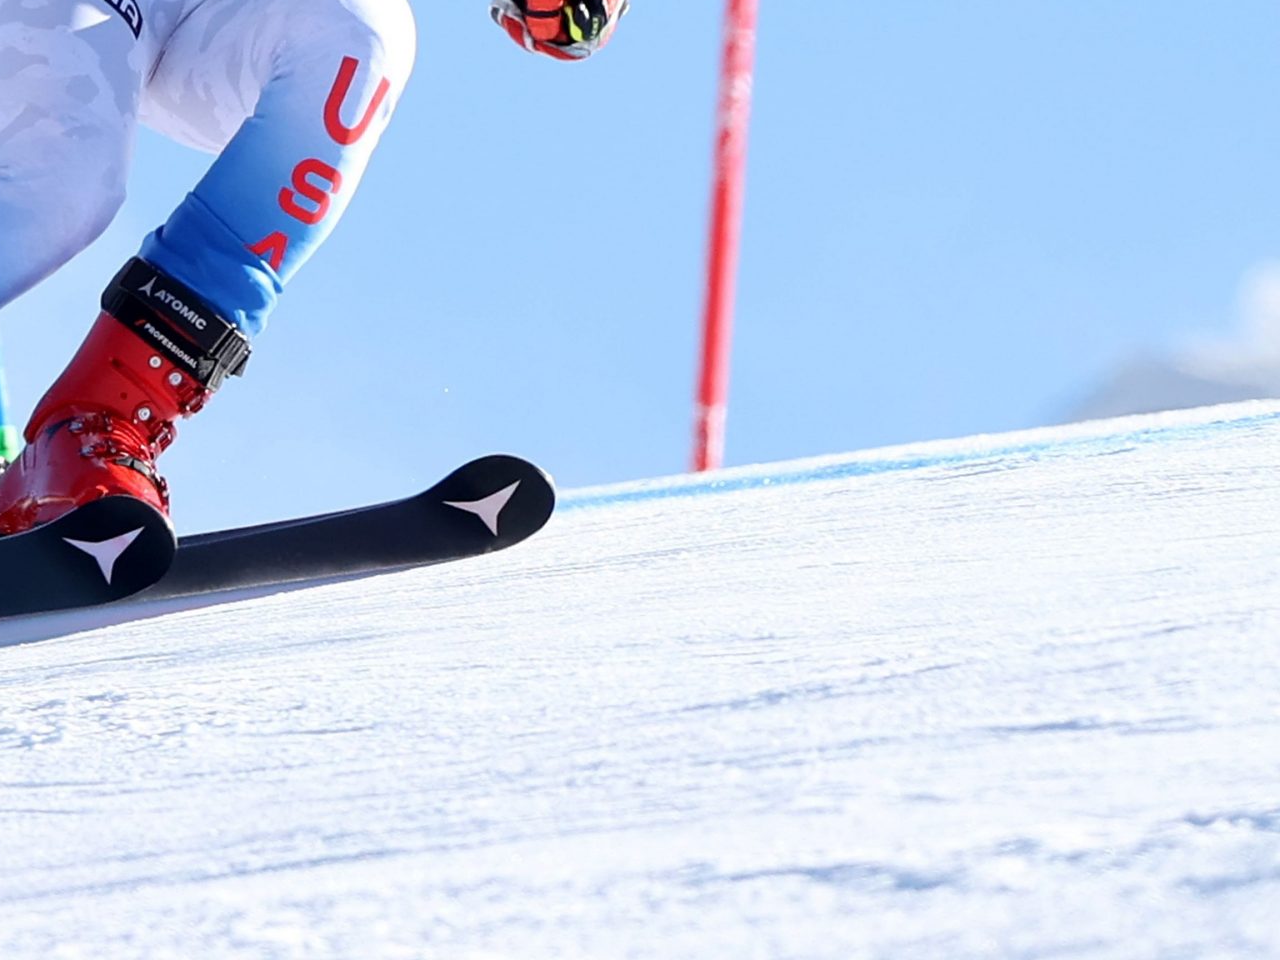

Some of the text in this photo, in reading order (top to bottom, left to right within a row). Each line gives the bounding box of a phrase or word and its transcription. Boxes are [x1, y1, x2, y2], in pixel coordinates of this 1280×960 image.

[243, 54, 391, 273] USA
[153, 289, 207, 330] ATOMIC
[143, 323, 198, 369] PROFESSIONAL
